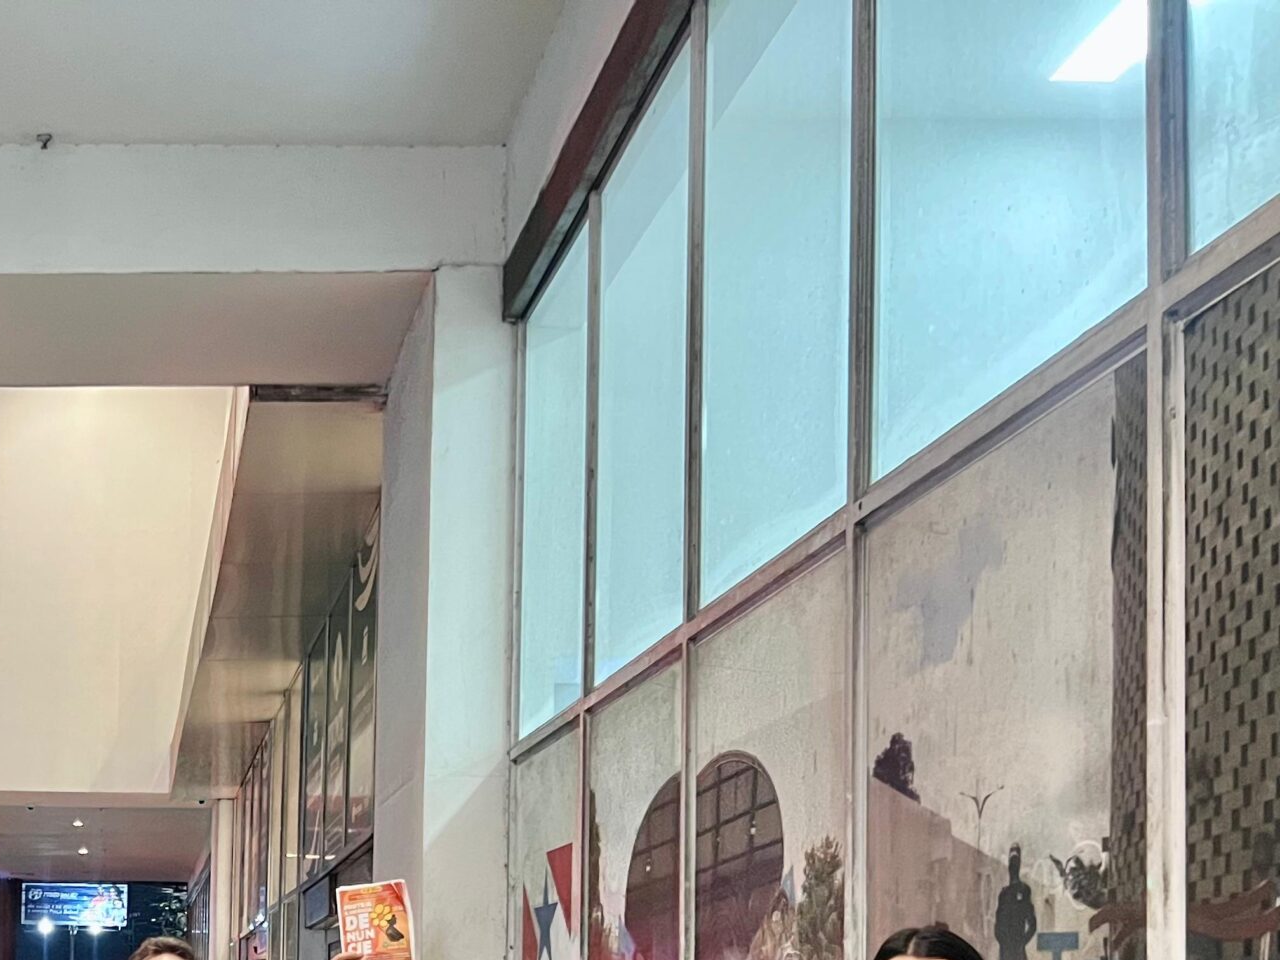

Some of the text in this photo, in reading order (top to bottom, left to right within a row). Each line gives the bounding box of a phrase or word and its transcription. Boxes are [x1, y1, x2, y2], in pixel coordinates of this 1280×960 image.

[344, 912, 370, 931] DE
[346, 928, 376, 942] NUN
[347, 940, 373, 955] CIE
